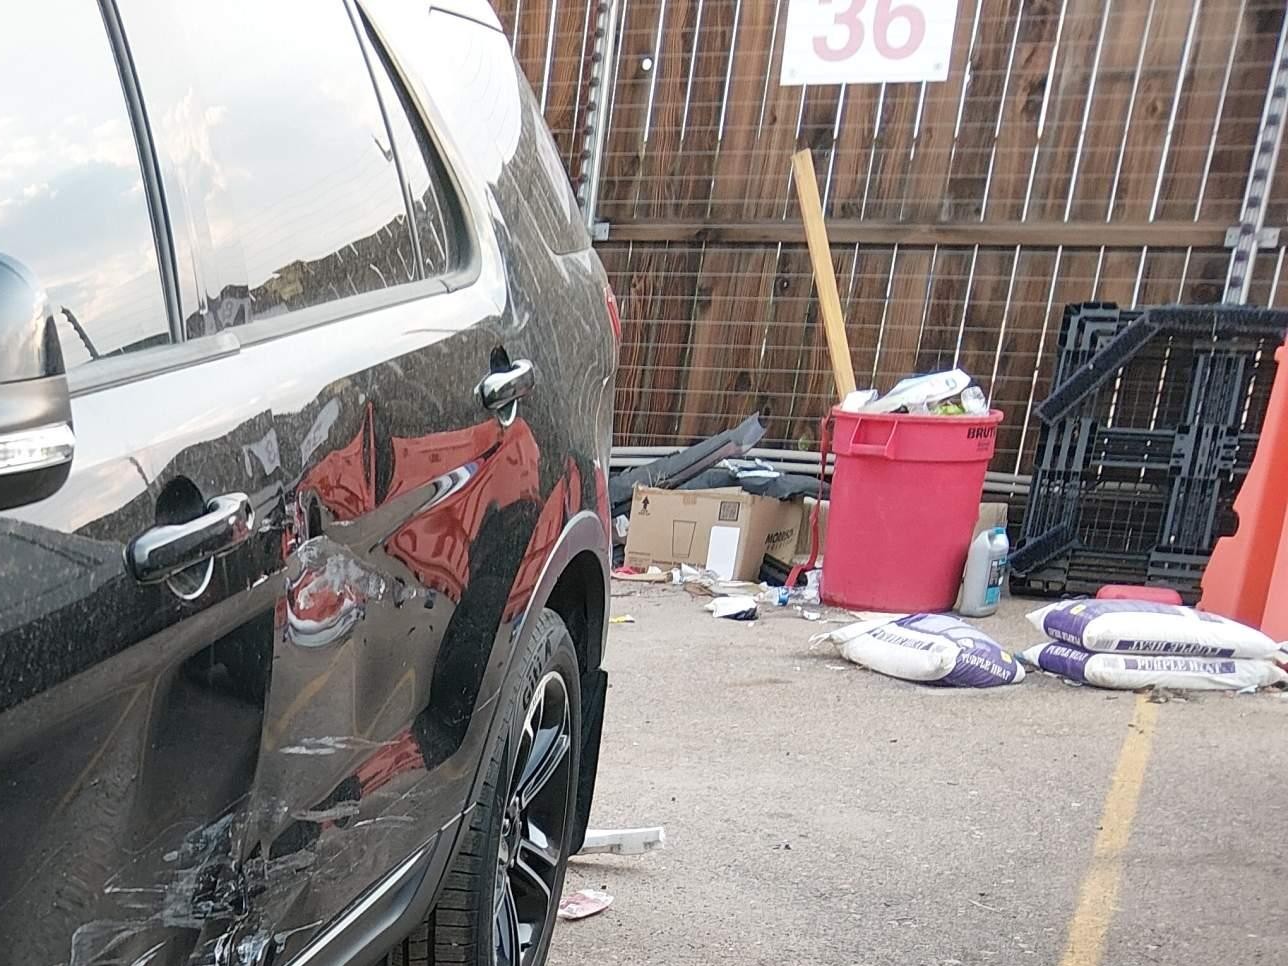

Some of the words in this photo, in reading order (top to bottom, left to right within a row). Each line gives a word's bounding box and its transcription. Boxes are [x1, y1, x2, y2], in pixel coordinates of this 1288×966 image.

[812, 0, 926, 61] 36
[962, 653, 992, 671] PURPLE
[991, 663, 1012, 681] HEAT
[1137, 659, 1188, 672] PURPLE
